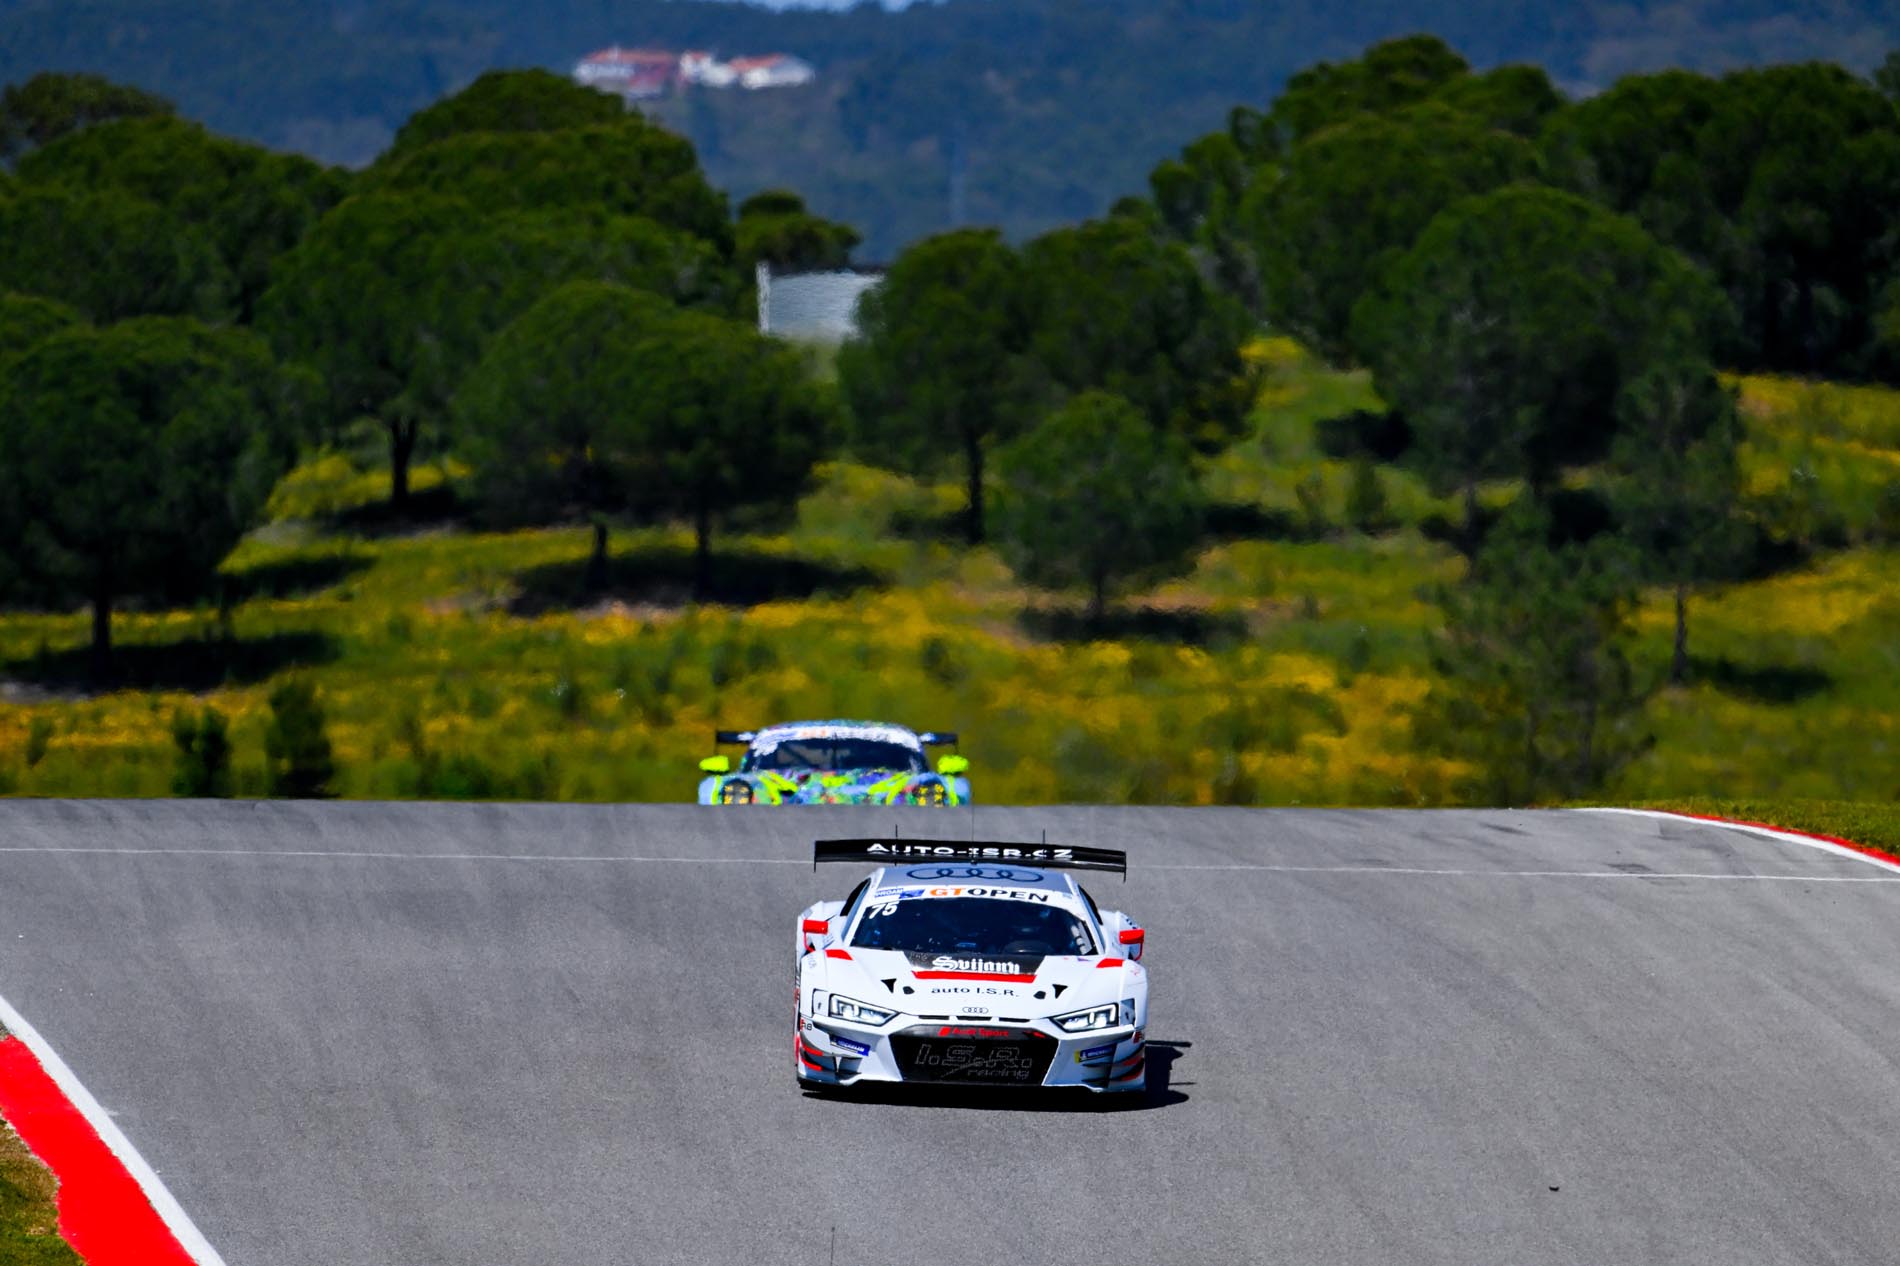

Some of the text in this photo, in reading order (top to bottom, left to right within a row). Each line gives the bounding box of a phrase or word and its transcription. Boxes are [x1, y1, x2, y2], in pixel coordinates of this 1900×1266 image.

[868, 902, 898, 919] 75
[952, 1027, 1009, 1038] Audi Sport
[967, 1068, 1030, 1080] racing
